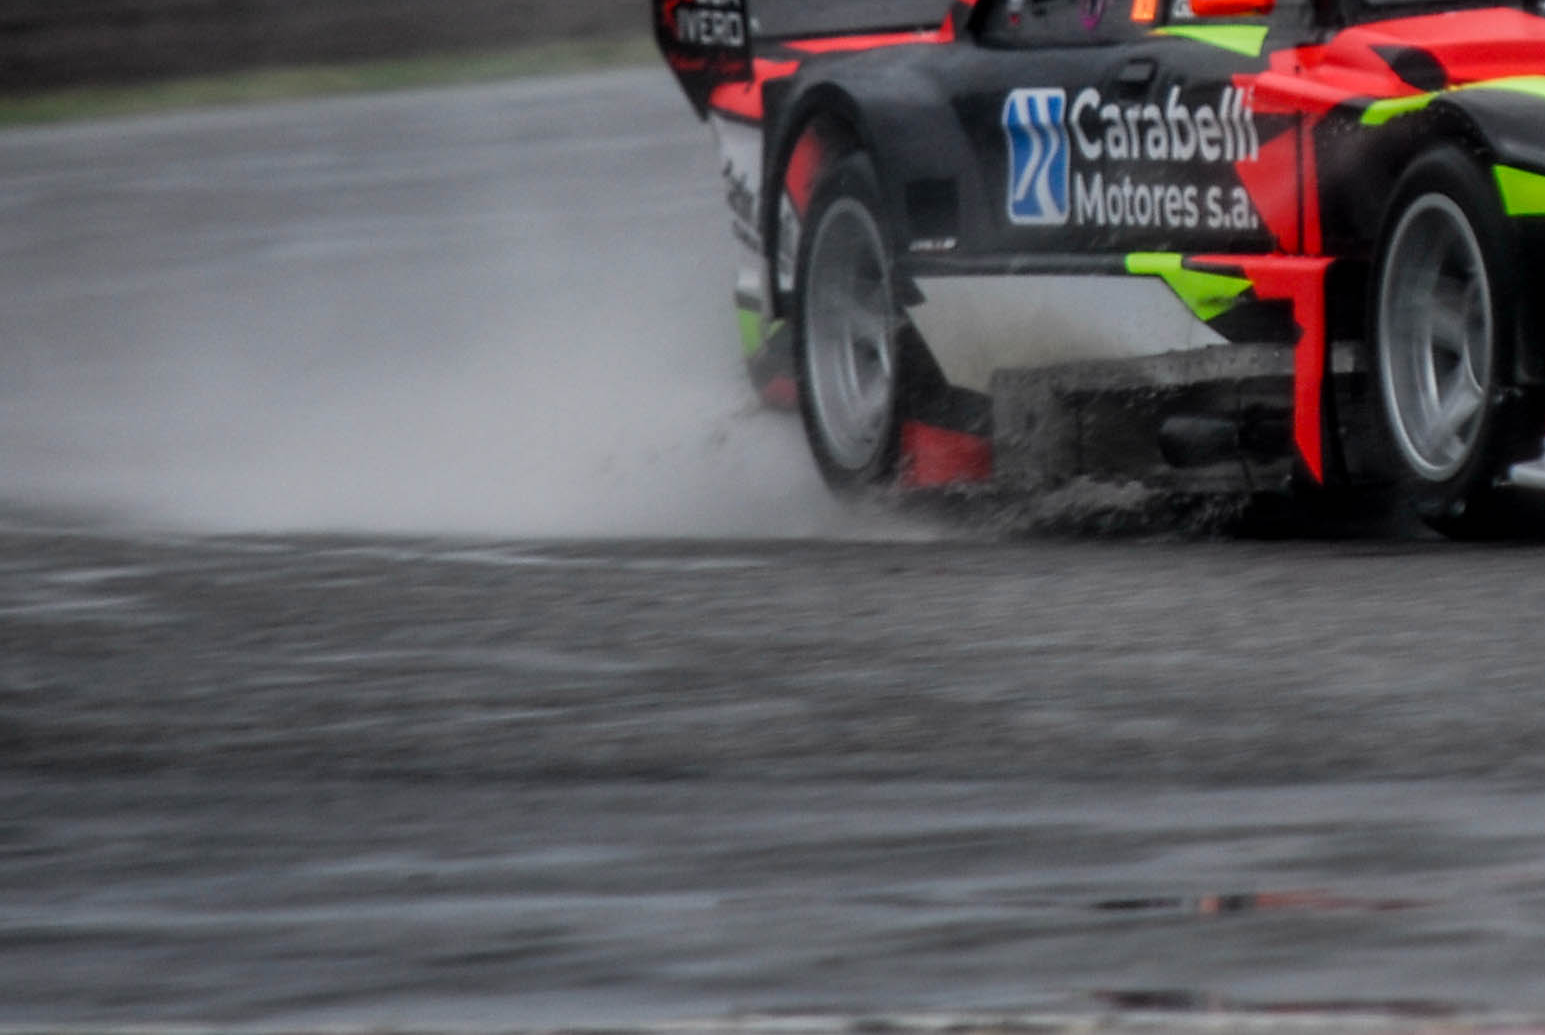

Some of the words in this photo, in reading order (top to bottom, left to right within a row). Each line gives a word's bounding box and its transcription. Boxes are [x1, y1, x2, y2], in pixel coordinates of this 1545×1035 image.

[1070, 85, 1259, 162] Carabelli
[1074, 172, 1200, 228] Motores
[1206, 185, 1259, 229] s.a.
